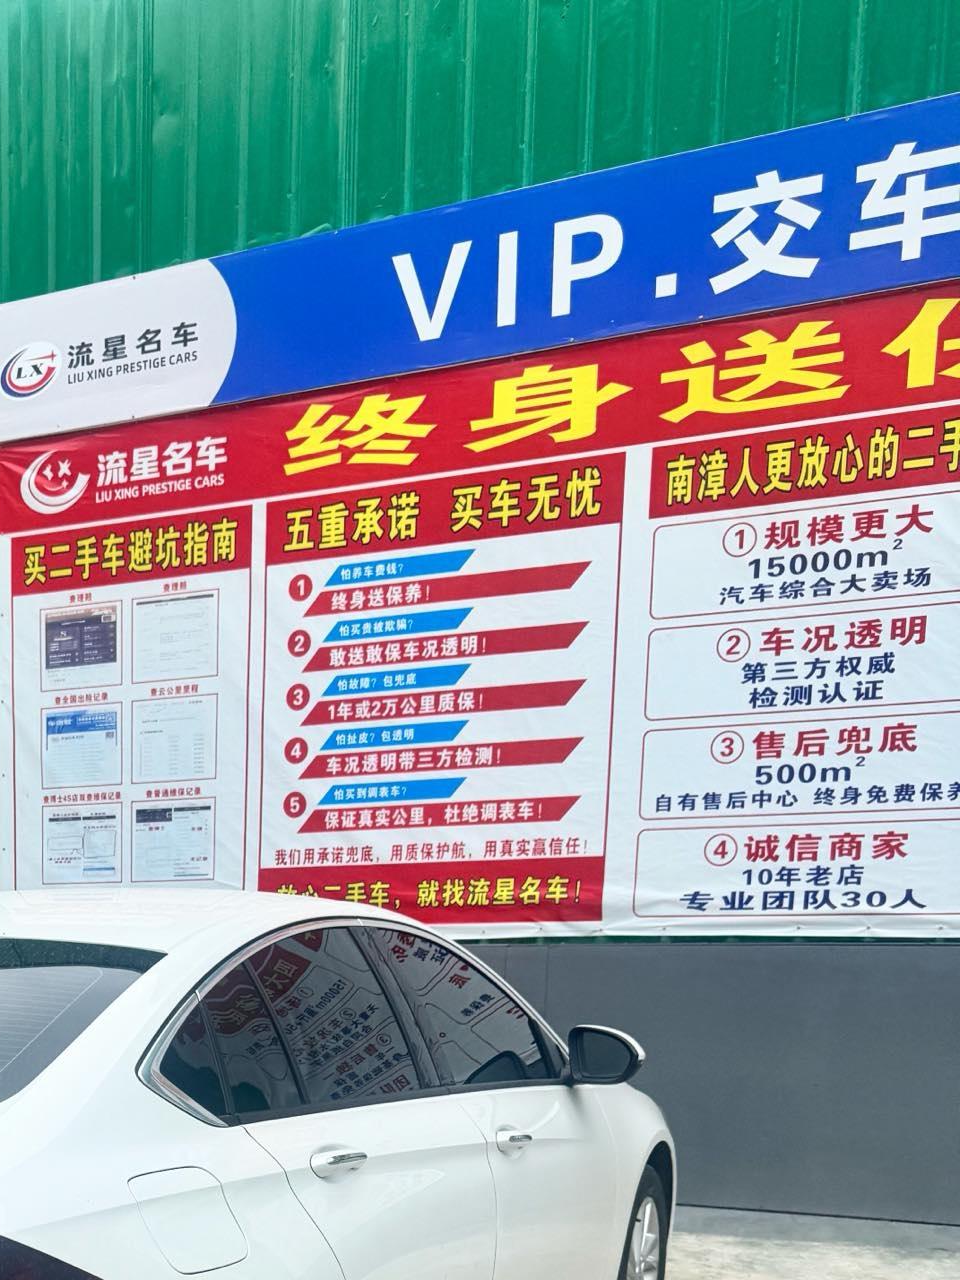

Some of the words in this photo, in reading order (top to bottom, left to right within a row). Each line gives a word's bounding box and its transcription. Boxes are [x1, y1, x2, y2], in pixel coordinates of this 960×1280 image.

[67, 321, 198, 370] 流星名车
[67, 371, 84, 385] LIU
[86, 367, 113, 381] XING
[116, 356, 166, 377] PRESTIGE
[169, 350, 198, 366] CARS
[96, 436, 228, 488] 流星名车
[95, 491, 112, 504] LIU
[114, 486, 139, 500] XING
[141, 477, 192, 497] PRESTIGE
[194, 473, 225, 488] CARS
[283, 491, 420, 552] 五重承诺
[451, 467, 602, 533] 买车无忧
[23, 518, 238, 586] 买二手车避坑指南
[720, 567, 932, 605] 汽车综合大卖场
[742, 652, 896, 684] 第三方权威
[749, 680, 884, 708] 检测认证
[655, 790, 798, 813] 自有售后中心
[742, 864, 865, 886] 10年老店
[680, 889, 927, 911] 专业团队30人
